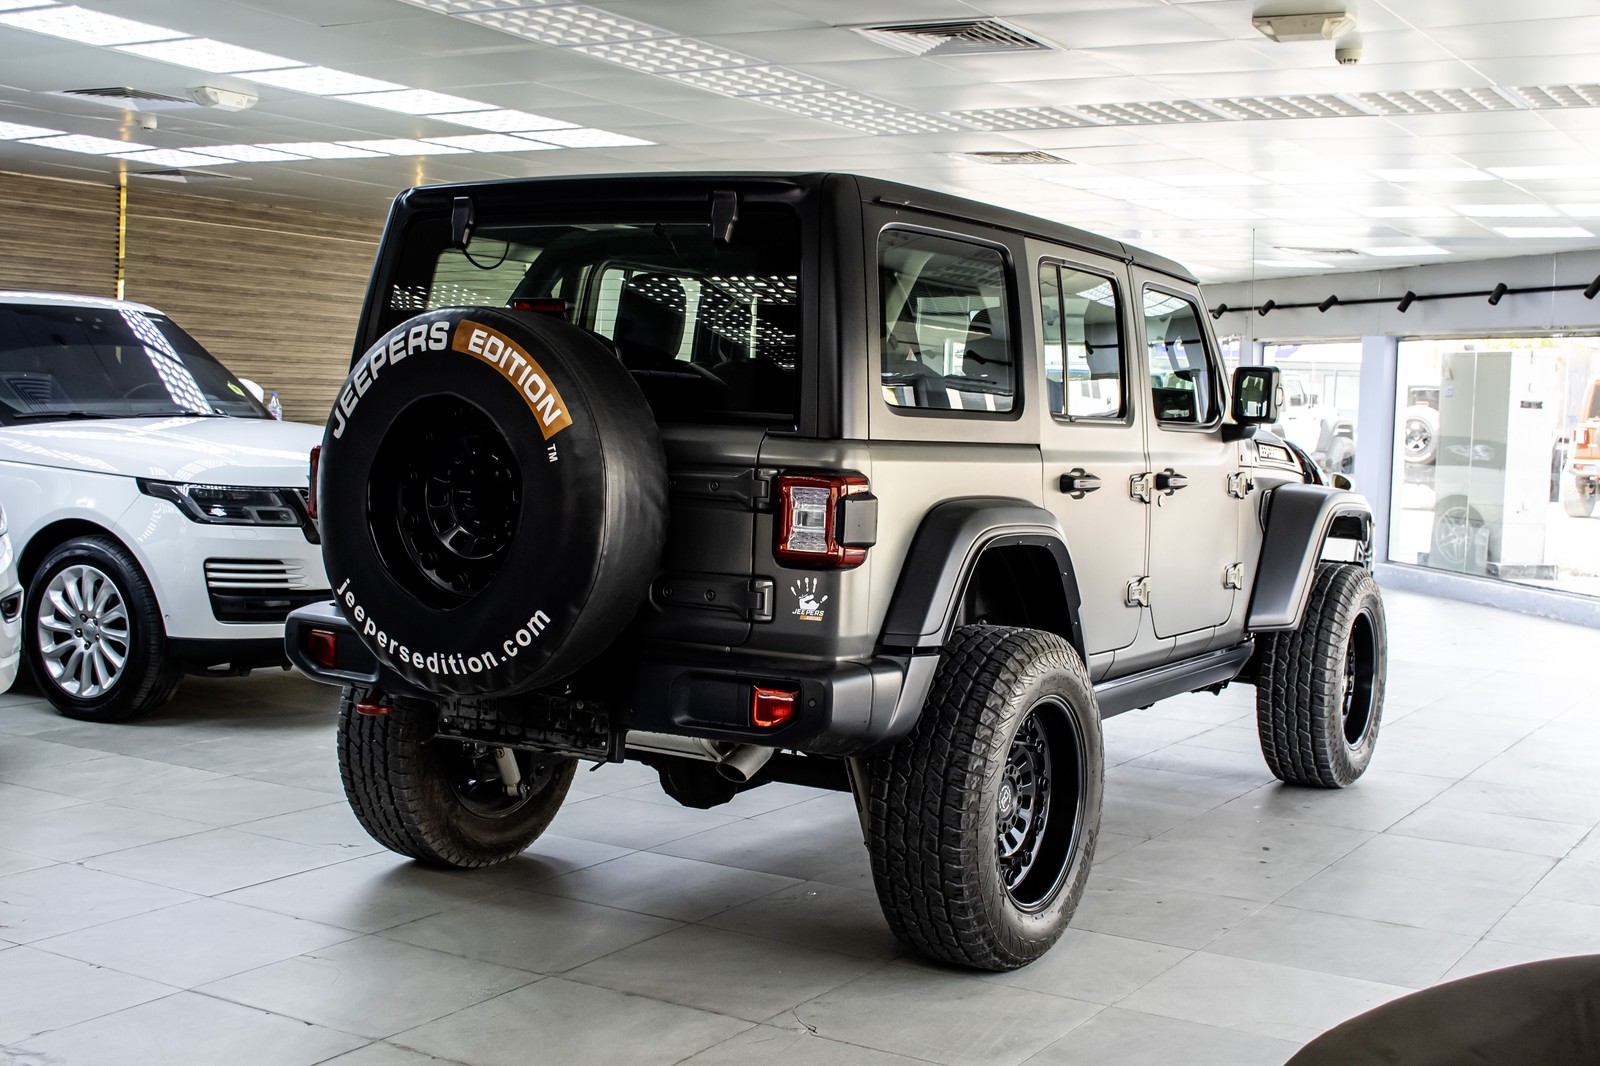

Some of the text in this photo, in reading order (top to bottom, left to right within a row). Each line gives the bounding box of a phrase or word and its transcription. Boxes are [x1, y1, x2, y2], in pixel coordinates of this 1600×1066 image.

[333, 321, 450, 439] JEEPERS
[467, 328, 562, 427] EDITION
[336, 578, 551, 675] jeepersedition.com
[792, 608, 825, 616] JEEPERS
